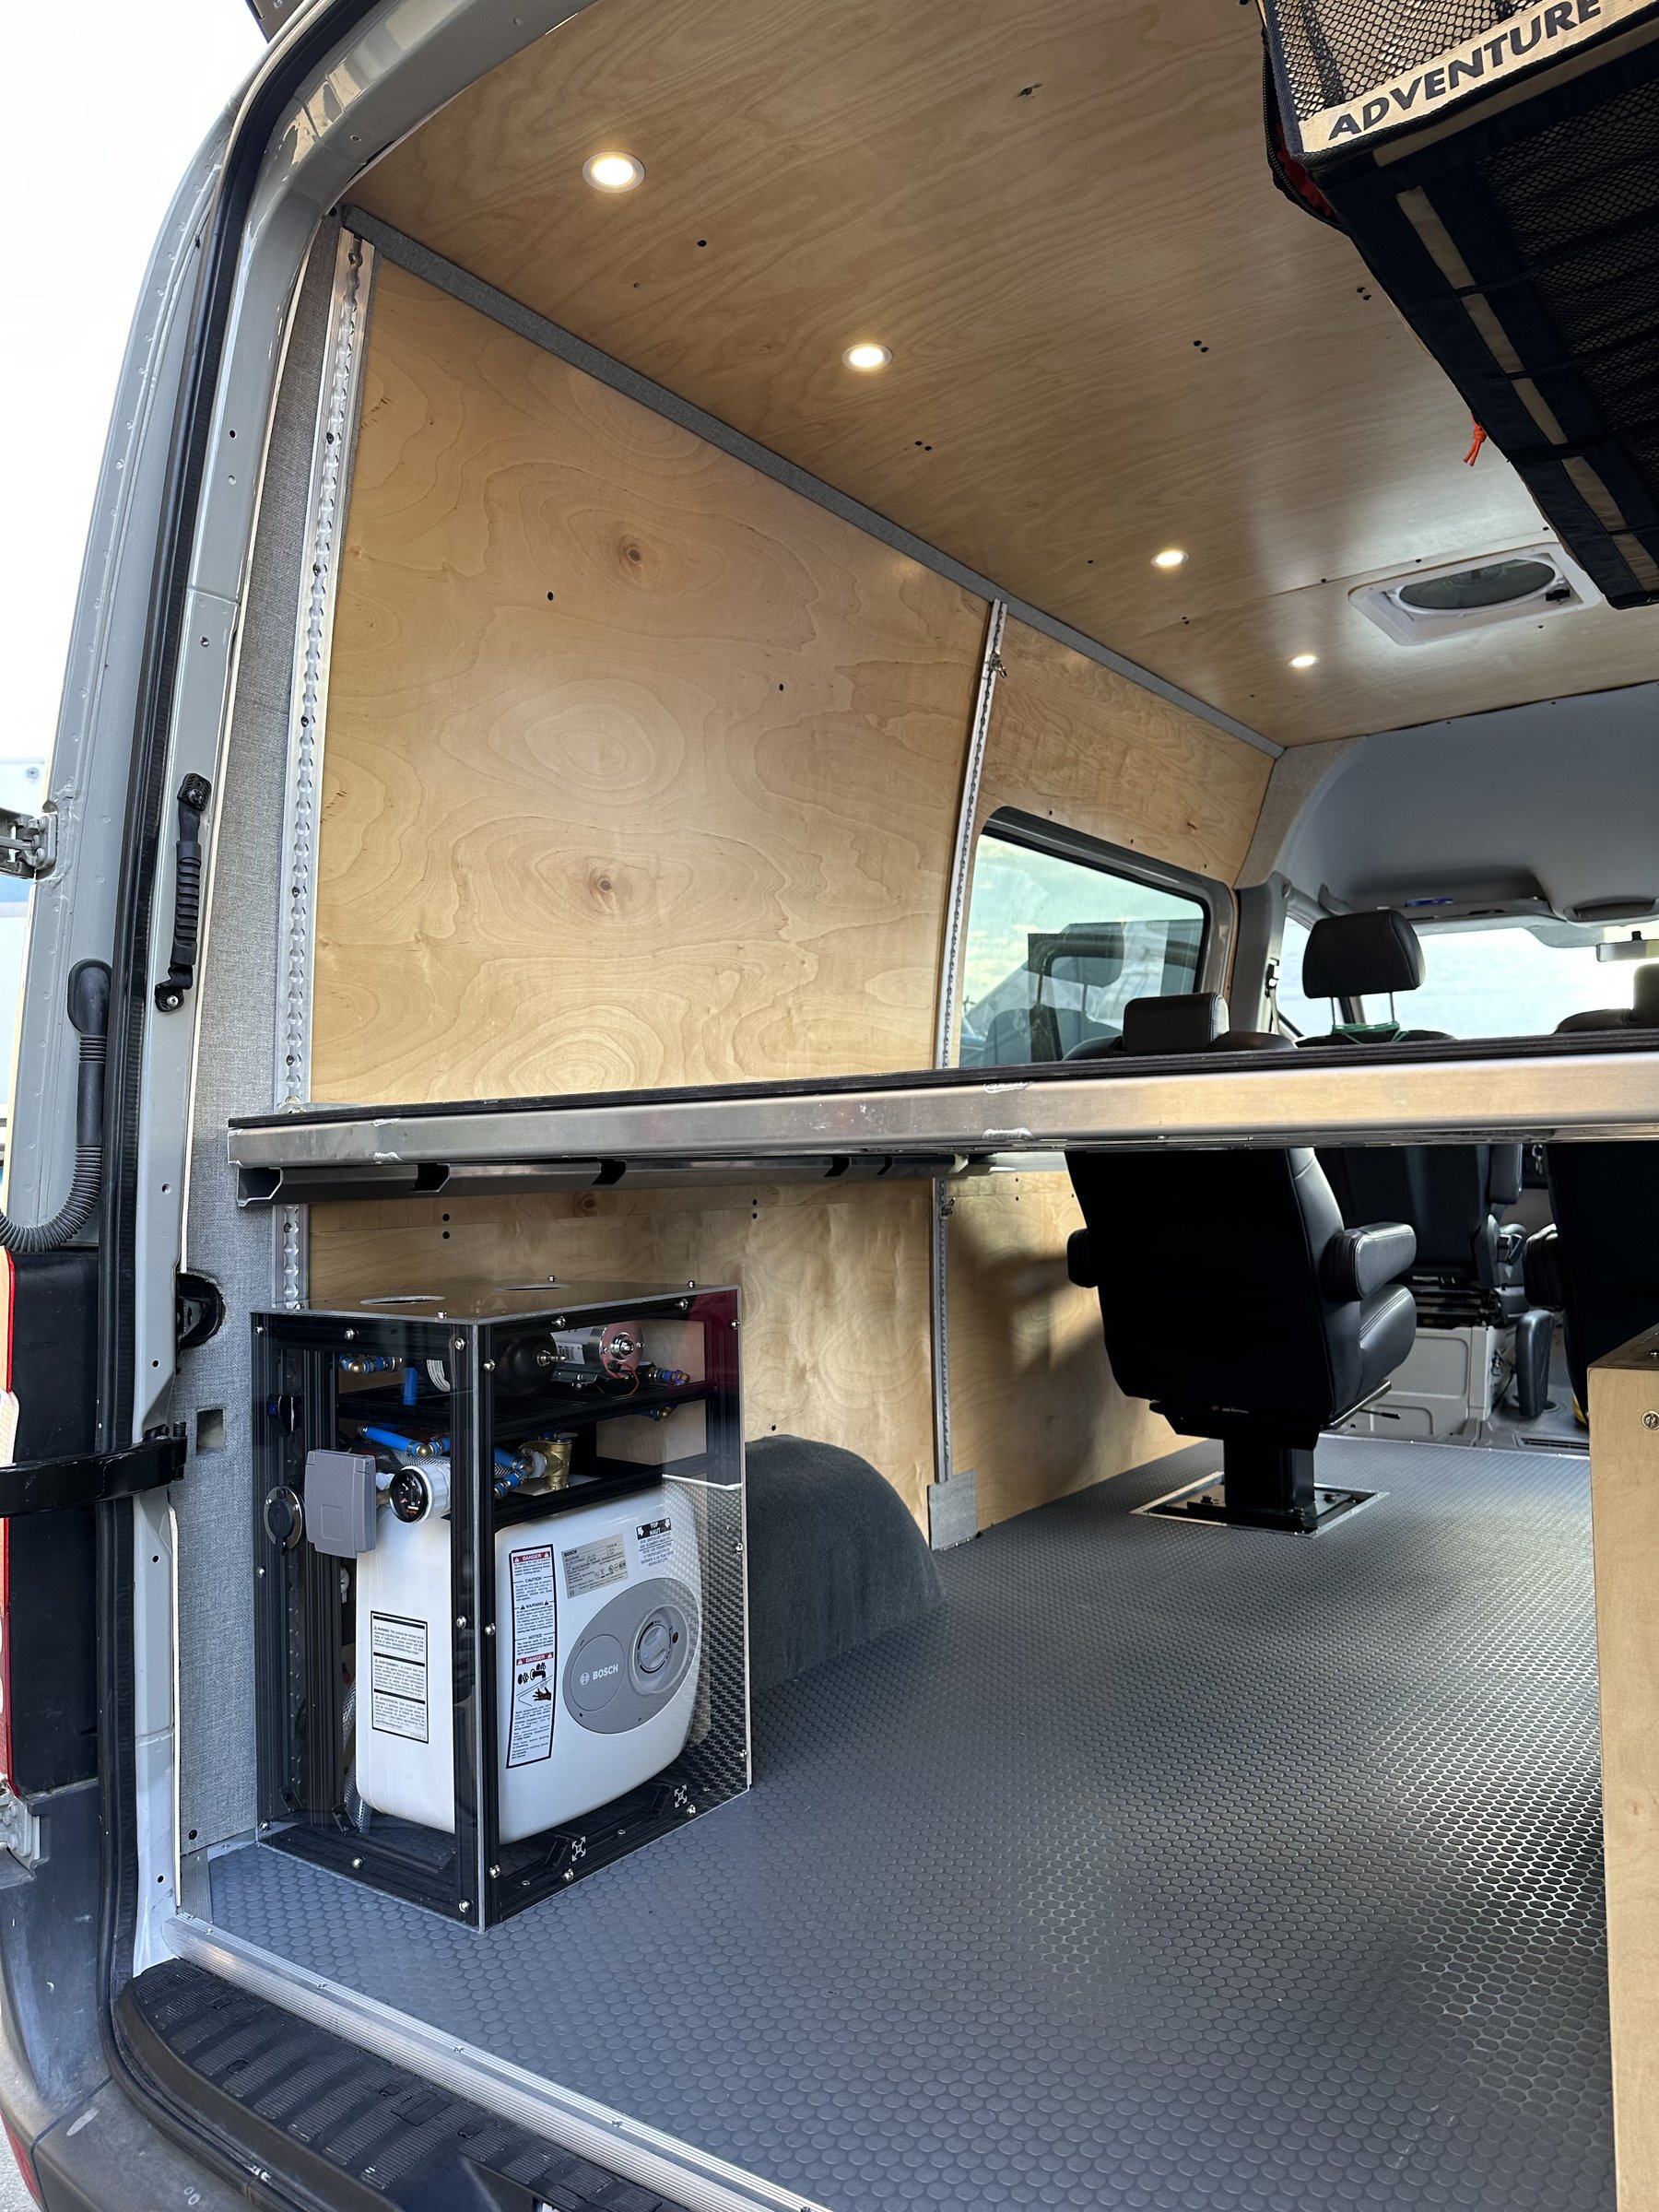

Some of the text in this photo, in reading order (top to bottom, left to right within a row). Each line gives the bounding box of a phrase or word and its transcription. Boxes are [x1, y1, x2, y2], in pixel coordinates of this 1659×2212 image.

[1328, 0, 1602, 141] ADVENTURE
[522, 1553, 542, 1561] DANGER
[525, 1601, 545, 1609] WARNING
[525, 1654, 546, 1664] DANGER
[593, 1664, 618, 1680] BOSCH
